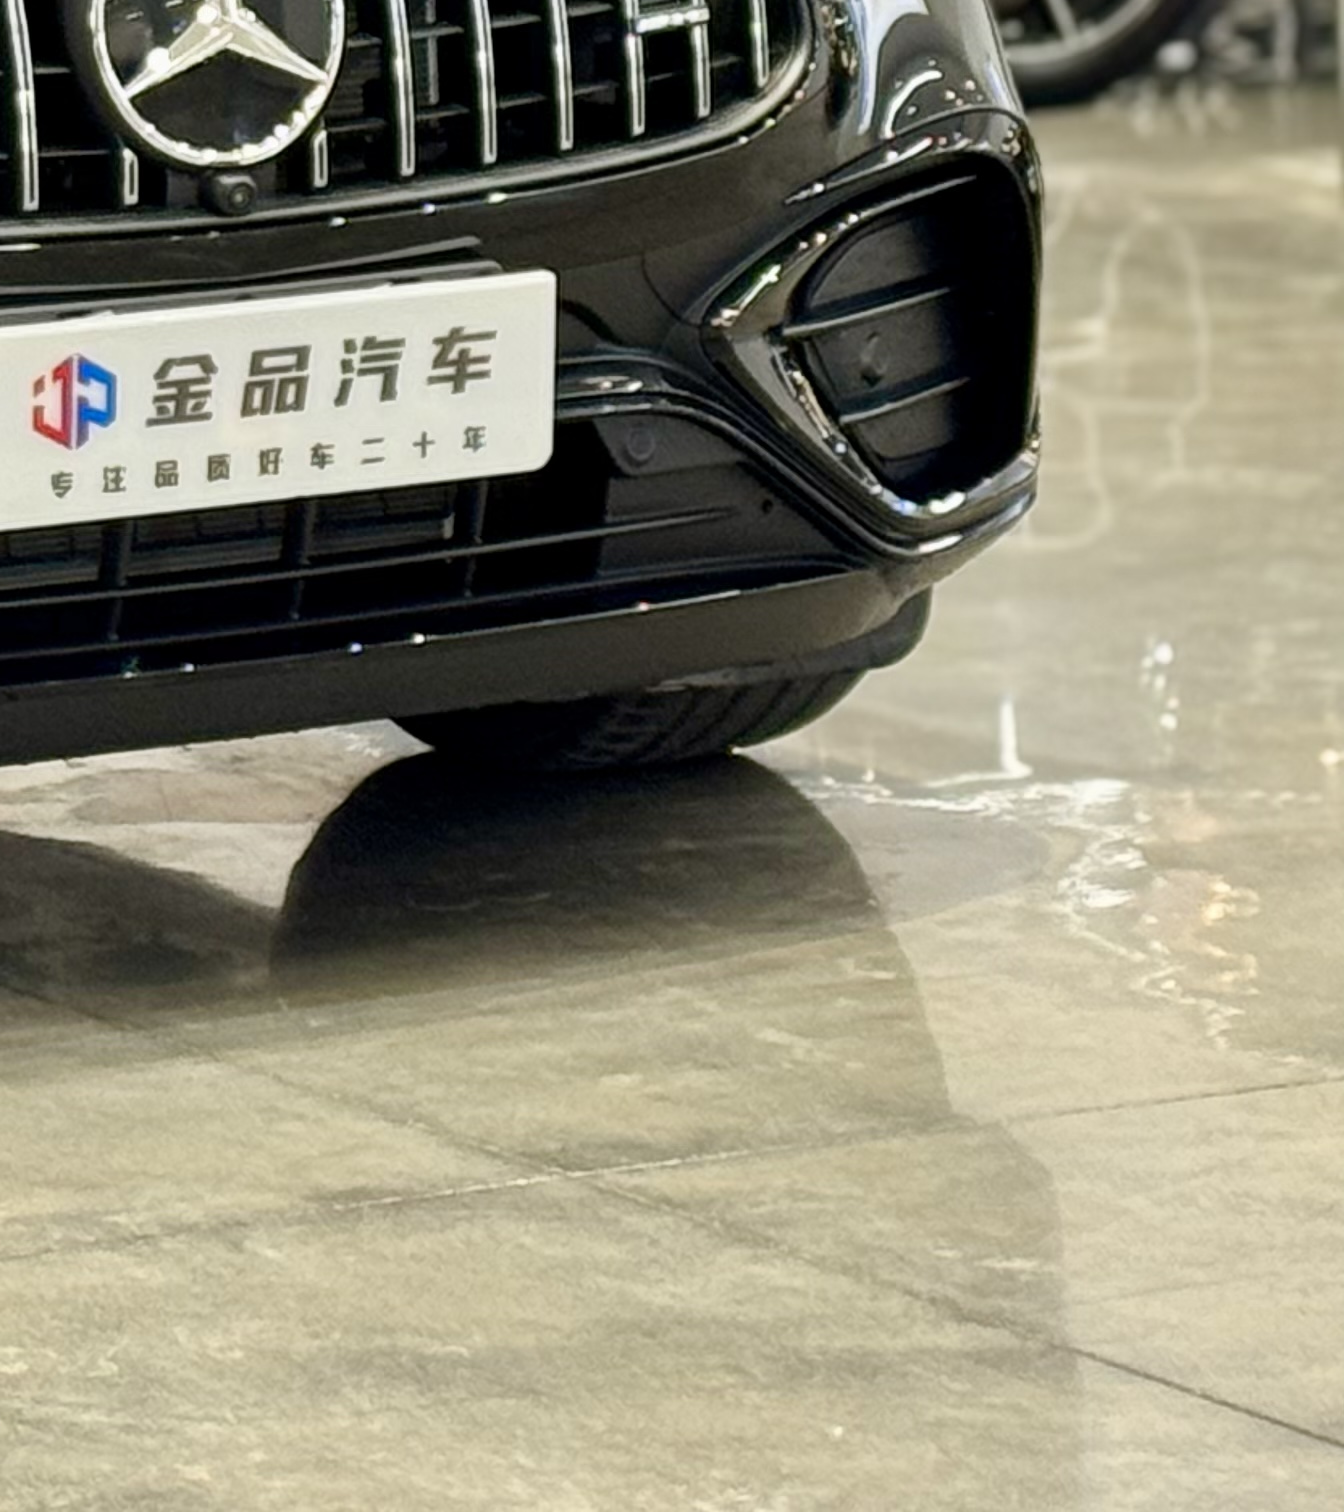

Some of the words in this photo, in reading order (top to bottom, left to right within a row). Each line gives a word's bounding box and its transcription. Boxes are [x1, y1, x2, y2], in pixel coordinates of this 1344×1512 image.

[145, 326, 498, 427] 金品汽车
[49, 426, 487, 499] 专注品质好车二十年
